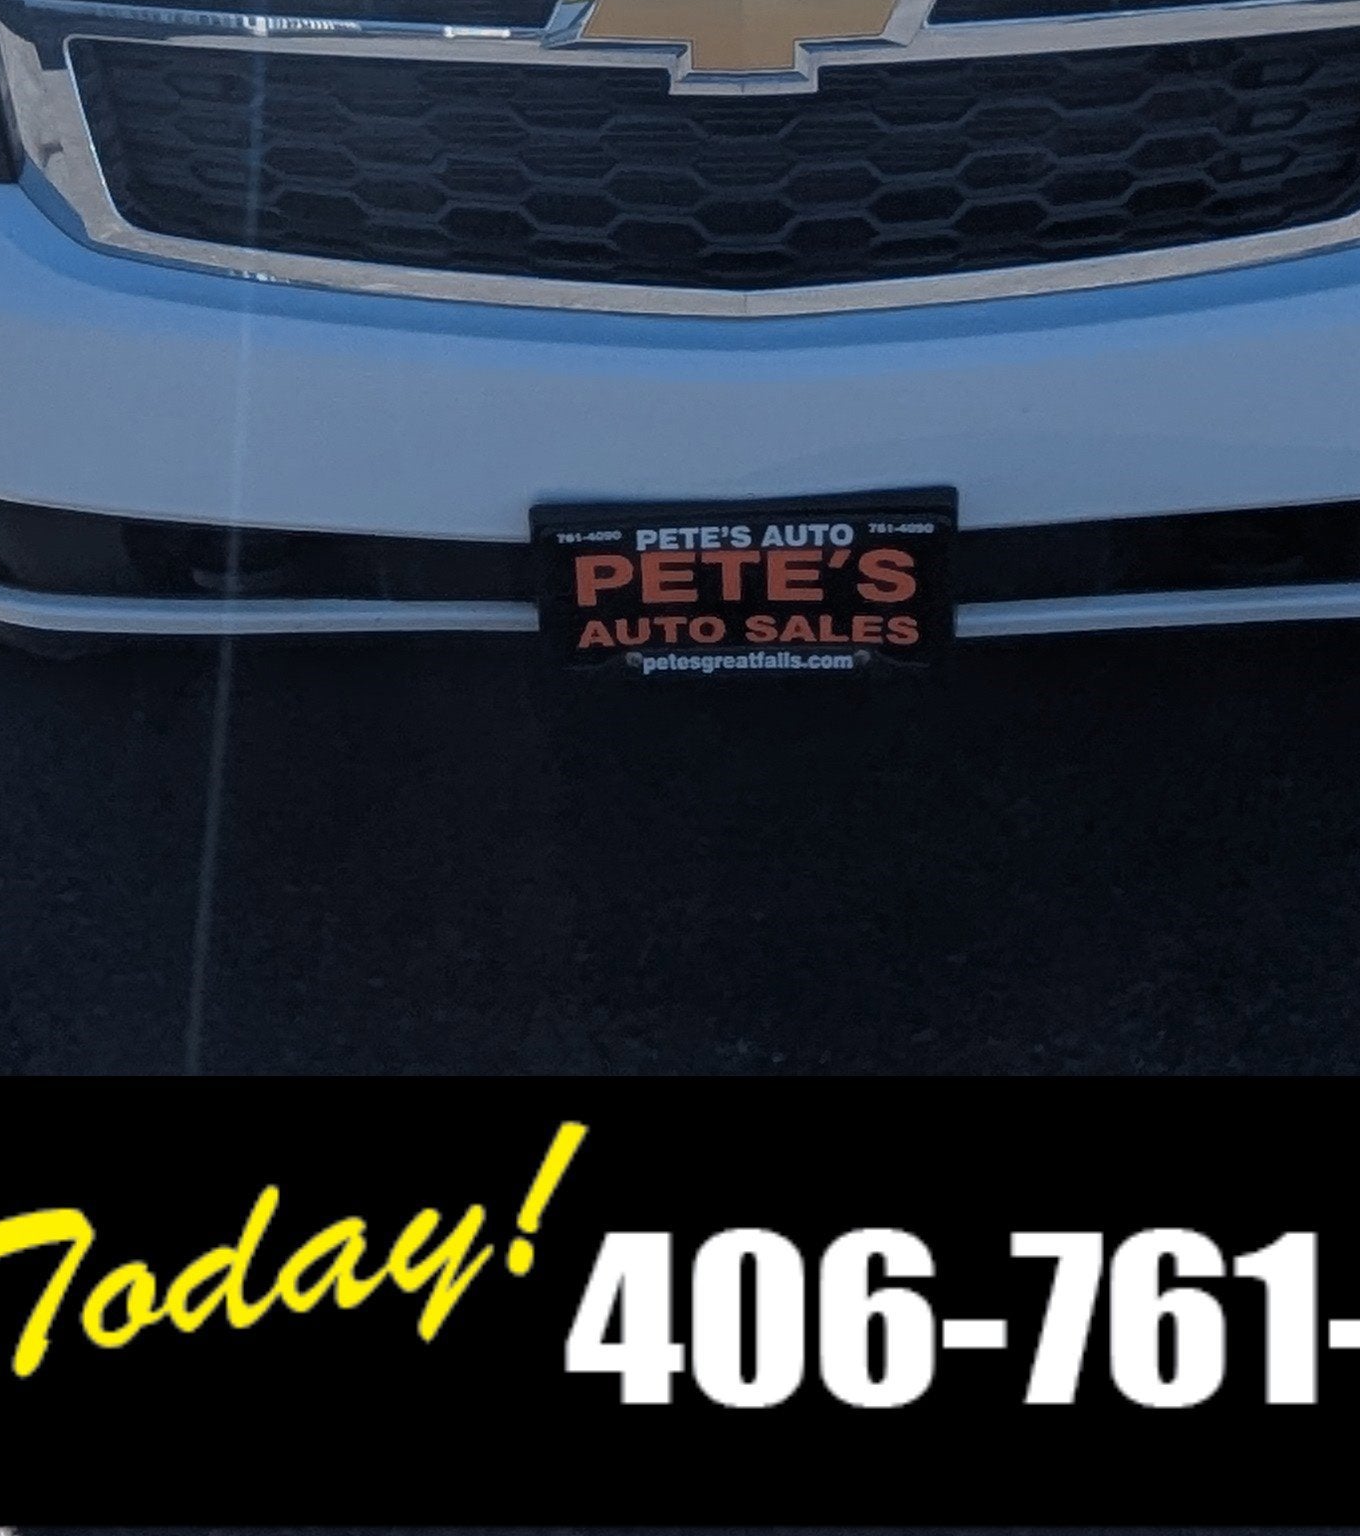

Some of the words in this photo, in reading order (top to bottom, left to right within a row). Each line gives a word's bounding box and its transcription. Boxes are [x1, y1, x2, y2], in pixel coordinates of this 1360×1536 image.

[636, 525, 752, 551] PETE'S
[762, 523, 854, 548] AUTO
[574, 547, 916, 607] PETE'S
[578, 615, 728, 648] AUTO
[744, 614, 920, 645] SALES
[643, 650, 854, 675] petesgreatfalls.com
